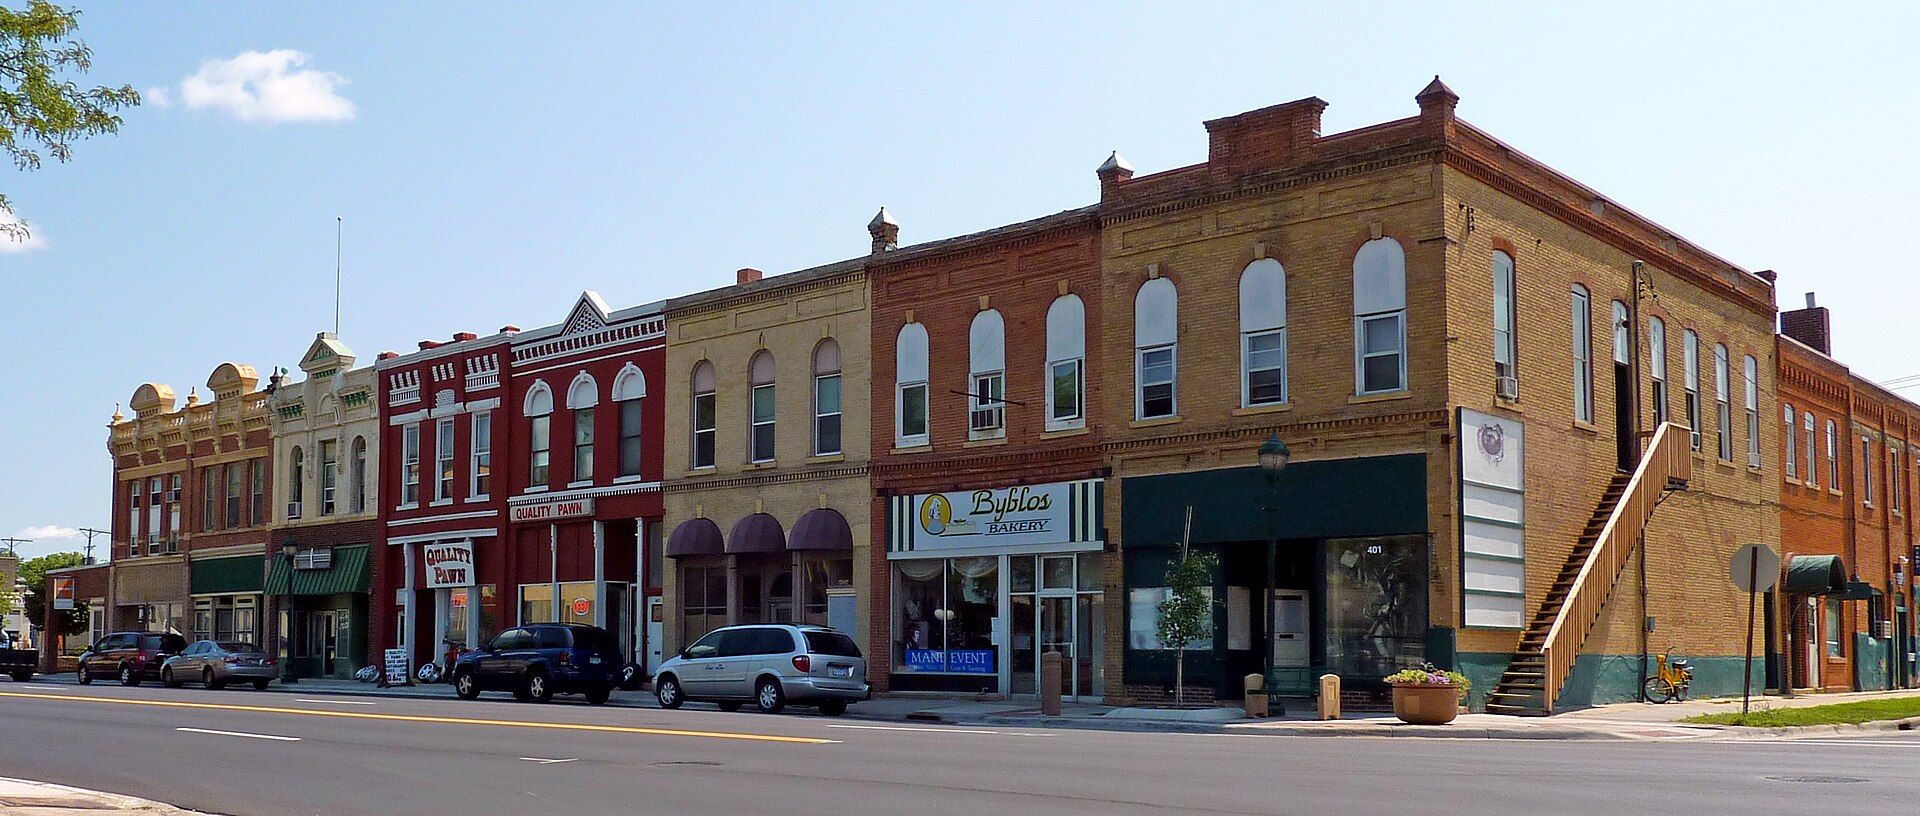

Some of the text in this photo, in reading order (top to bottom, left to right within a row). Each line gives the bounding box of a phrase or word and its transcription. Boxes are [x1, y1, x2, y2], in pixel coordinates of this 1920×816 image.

[516, 502, 582, 519] QUALITY PAWN
[969, 486, 1052, 521] Byblos
[989, 521, 1049, 533] BAKERY
[427, 547, 471, 566] QUALITY
[1367, 545, 1382, 554] 401
[433, 566, 466, 584] PAWN
[951, 652, 986, 664] EVENT
